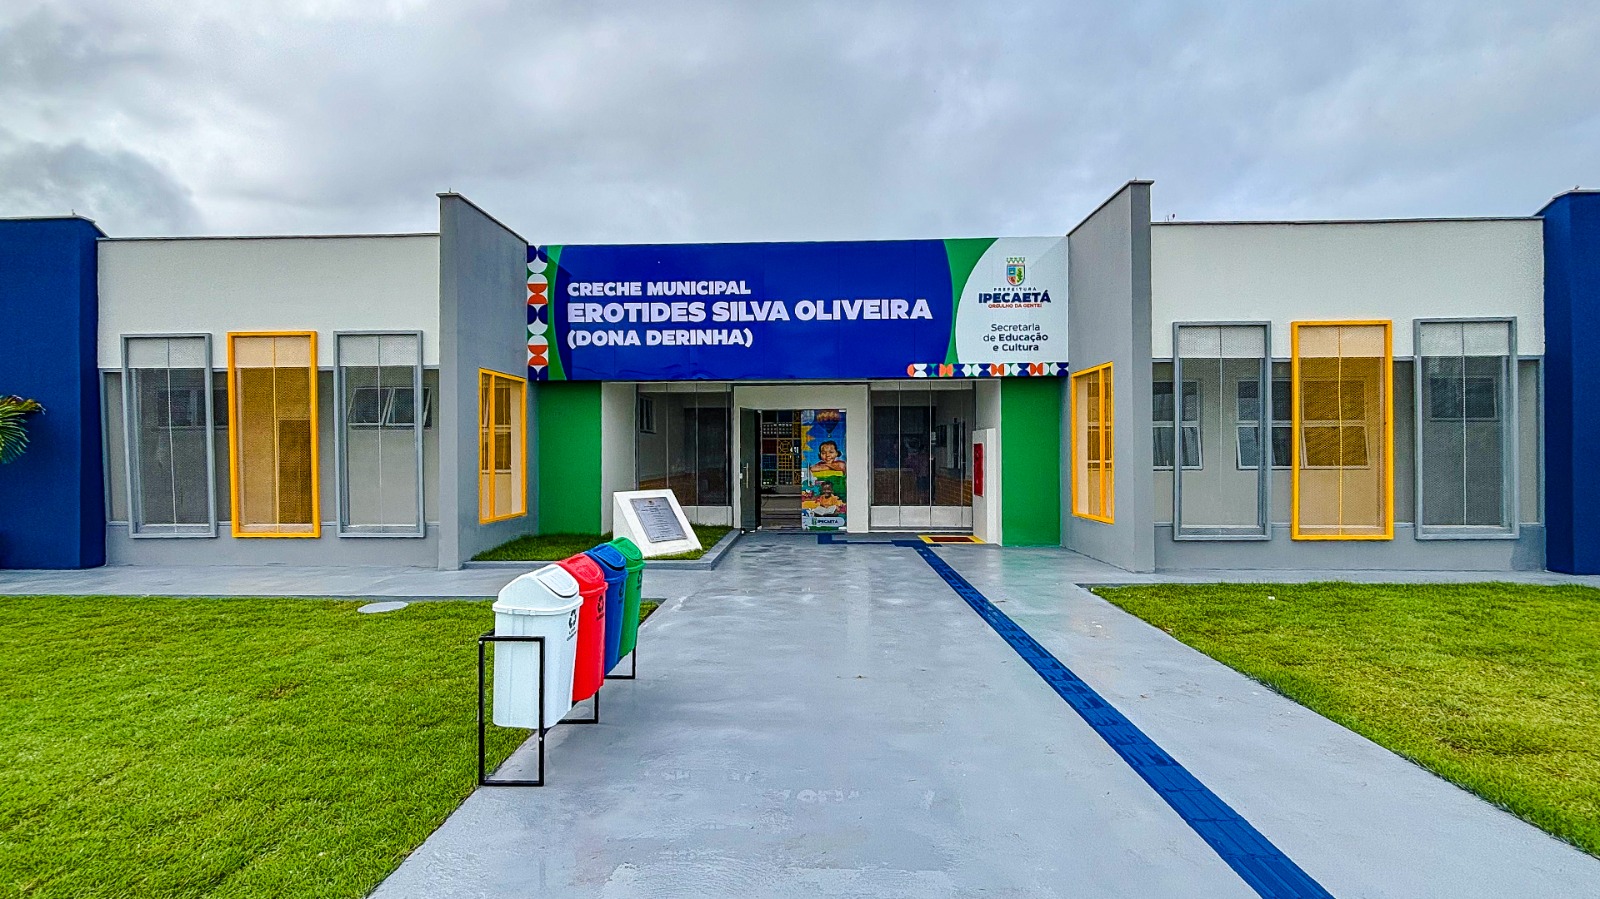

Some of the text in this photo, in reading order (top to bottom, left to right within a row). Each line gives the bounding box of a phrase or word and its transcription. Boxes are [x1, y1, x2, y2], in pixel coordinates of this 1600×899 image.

[567, 280, 751, 297] CRECHE MUNICIPAL
[978, 290, 1051, 303] IPECAETÁ
[567, 299, 934, 323] EROTIDES SILVA OLIVEIRA
[990, 323, 1040, 332] Secretaria
[567, 327, 753, 349] (DONA DERINHA)
[983, 332, 1048, 342] de Educação
[1002, 343, 1039, 352] Cultura
